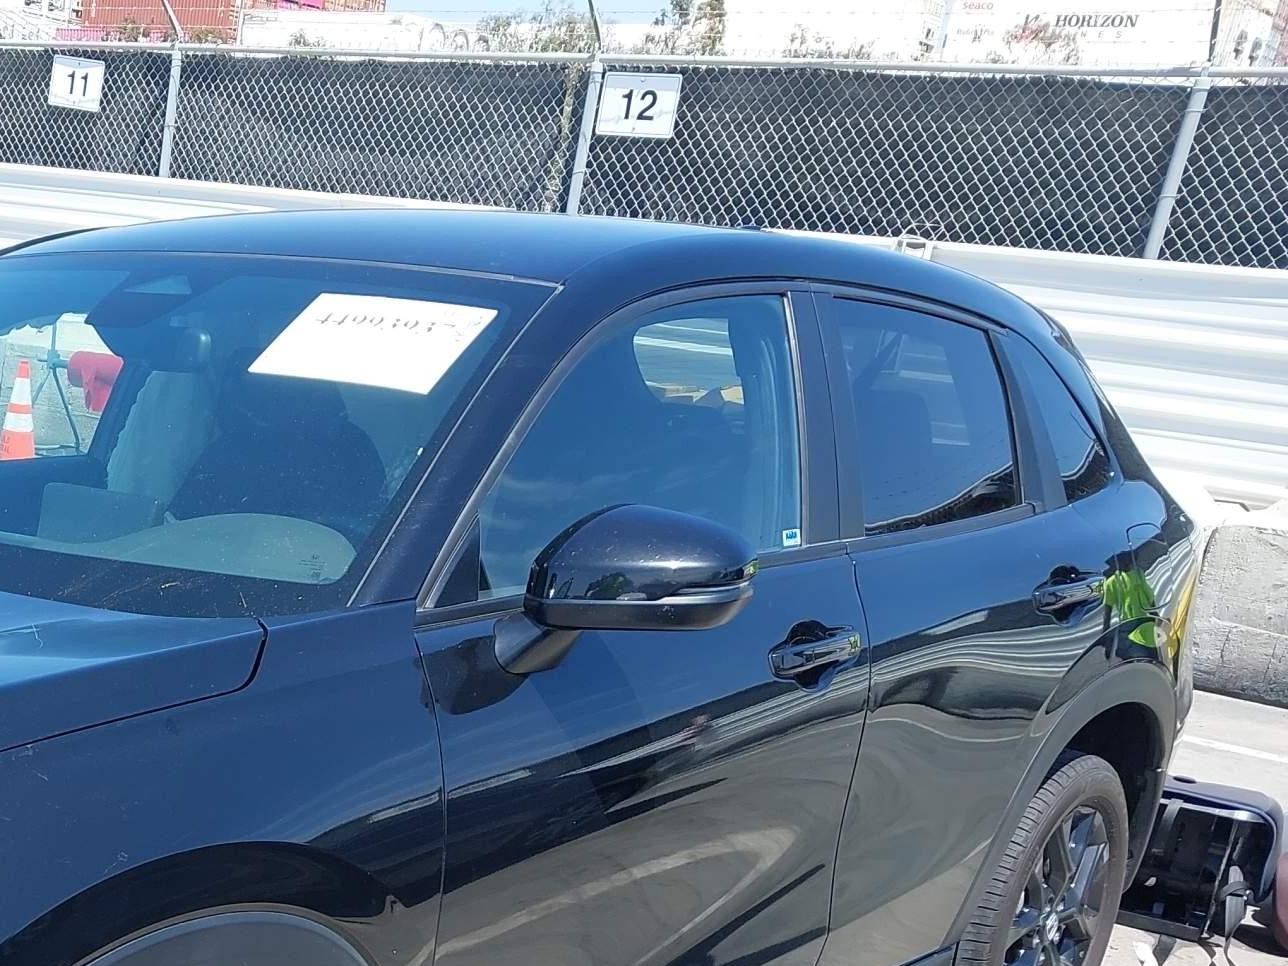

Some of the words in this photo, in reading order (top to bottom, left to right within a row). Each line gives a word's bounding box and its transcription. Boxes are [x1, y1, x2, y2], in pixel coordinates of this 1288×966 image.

[1054, 13, 1140, 29] HORIZON
[67, 70, 89, 97] 11
[622, 88, 658, 121] 12
